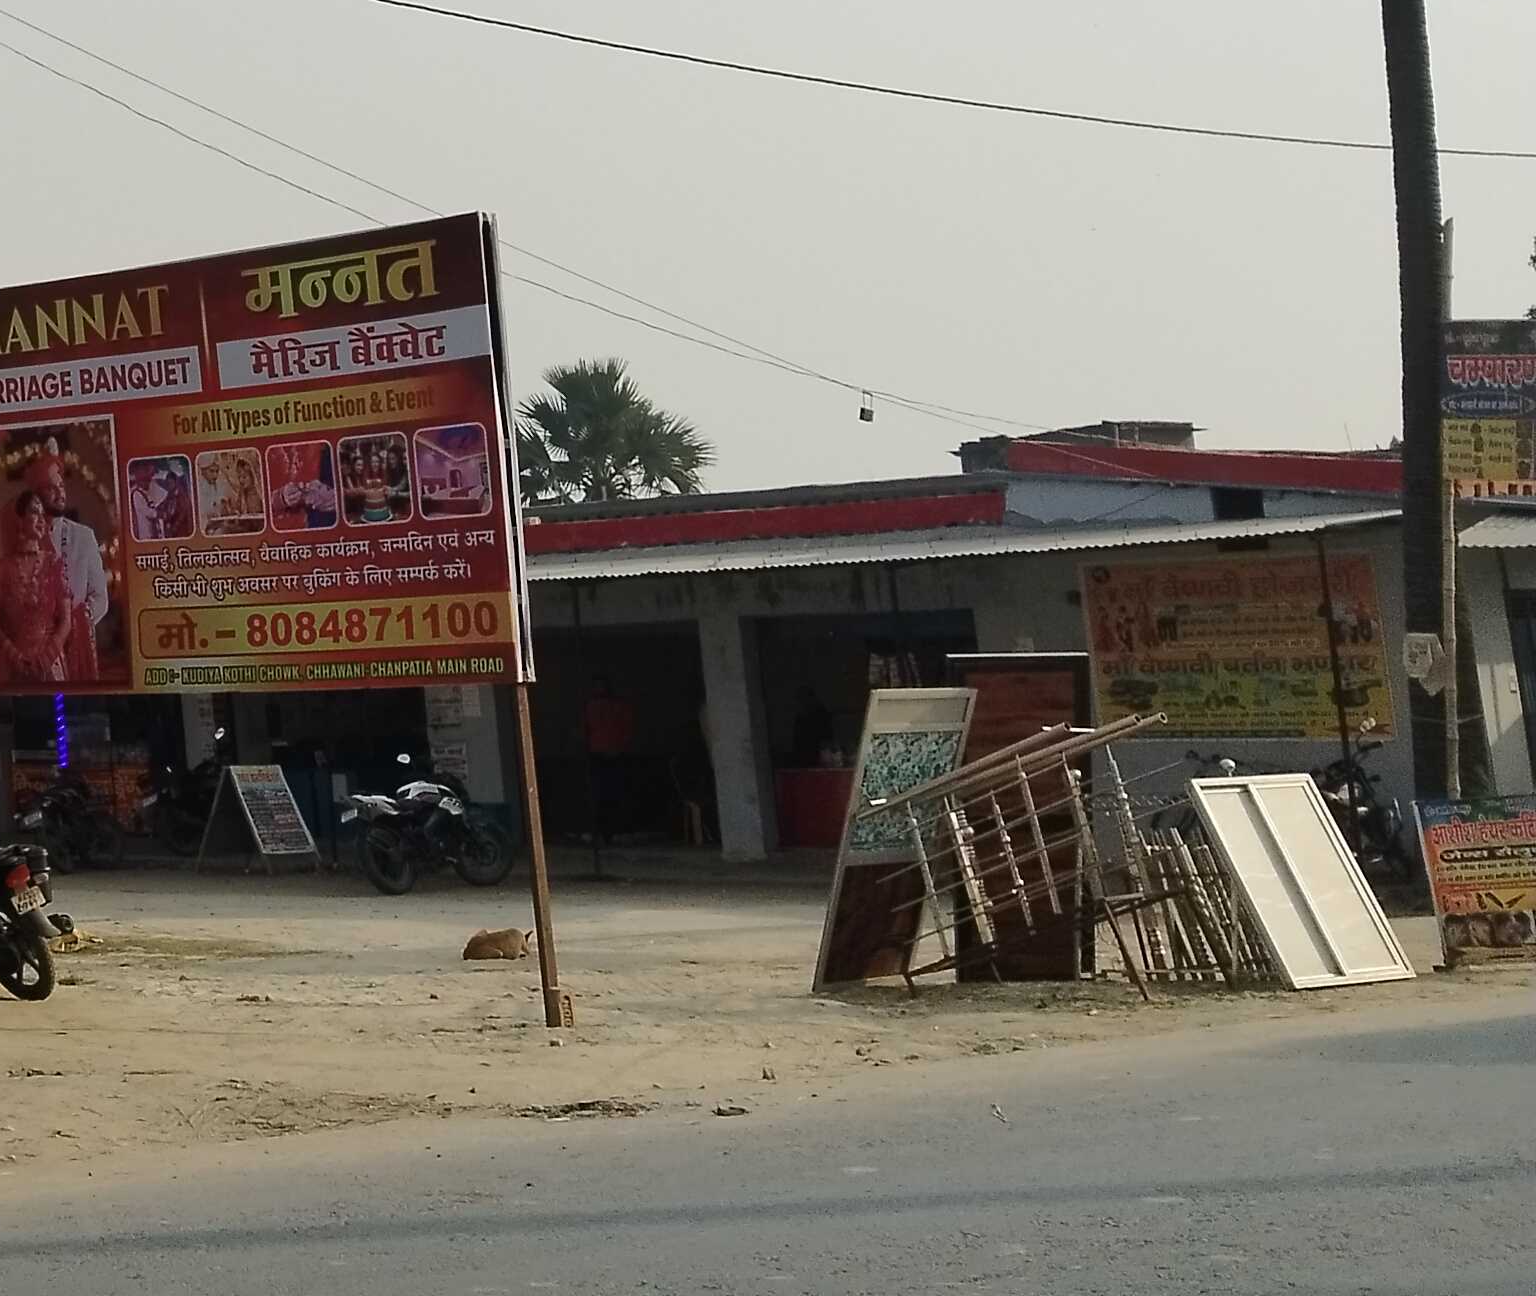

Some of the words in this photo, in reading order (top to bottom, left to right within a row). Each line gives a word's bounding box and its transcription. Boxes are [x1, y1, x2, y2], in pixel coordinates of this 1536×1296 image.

[241, 239, 440, 318] मन्नत
[249, 337, 341, 379] मैरिज
[347, 323, 447, 366] बैंक्वेट
[79, 357, 190, 395] BANQUET
[173, 412, 197, 436] For
[200, 407, 222, 431] All
[221, 404, 271, 434] Types
[274, 402, 291, 425] of
[293, 394, 366, 423] Function
[370, 391, 383, 413] &
[386, 386, 434, 412] Event
[136, 549, 175, 573] सगाई,
[259, 541, 312, 562] वैवाहिक
[315, 537, 375, 559] कार्यक्रम,
[379, 531, 433, 553] जन्मदिन
[437, 529, 459, 552] एवं
[464, 529, 495, 547] अन्य
[154, 576, 189, 598] किसी
[191, 574, 209, 596] भी
[211, 578, 233, 600] शुभ
[238, 576, 278, 594] अवसर
[281, 576, 299, 591] पर
[303, 567, 341, 596] बुकिंग
[345, 567, 359, 586] के
[363, 564, 393, 587] लिए
[397, 559, 440, 583] सम्पर्क
[247, 600, 498, 647] 8084871100
[145, 668, 167, 685] ADD
[182, 667, 222, 684] KUDIYA
[223, 666, 257, 683] KOTHI
[437, 659, 467, 675] MAIN
[472, 657, 504, 674] ROAD
